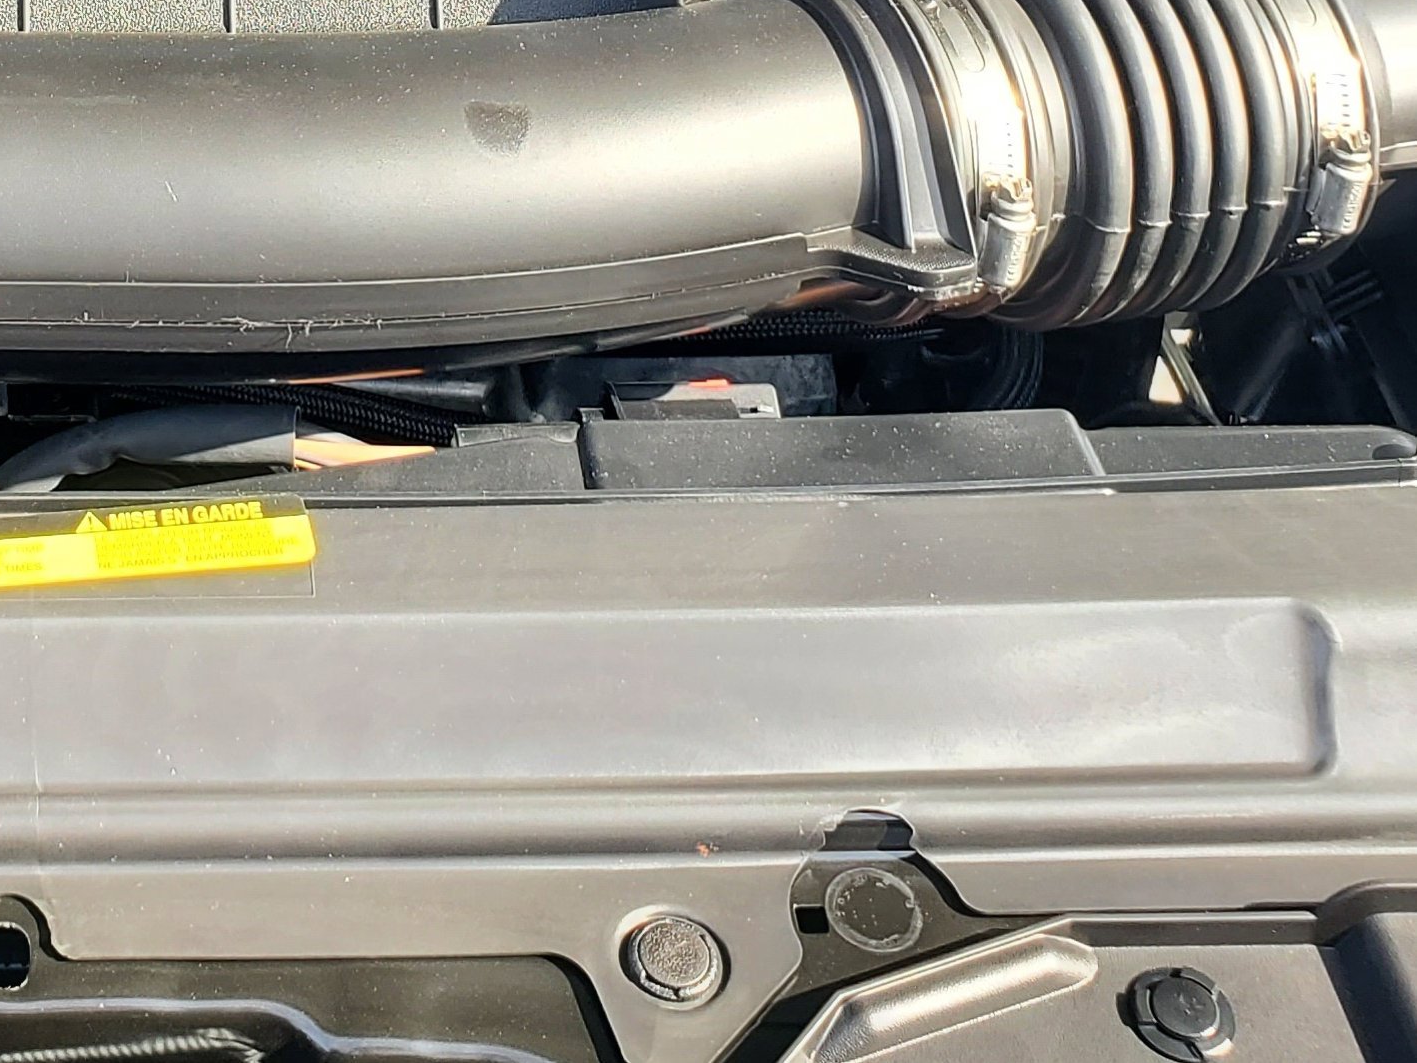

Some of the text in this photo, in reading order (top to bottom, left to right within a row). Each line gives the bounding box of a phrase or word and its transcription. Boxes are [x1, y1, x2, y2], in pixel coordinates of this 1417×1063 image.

[108, 509, 158, 530] MISE
[160, 507, 189, 526] EN
[191, 501, 264, 523] GARDE
